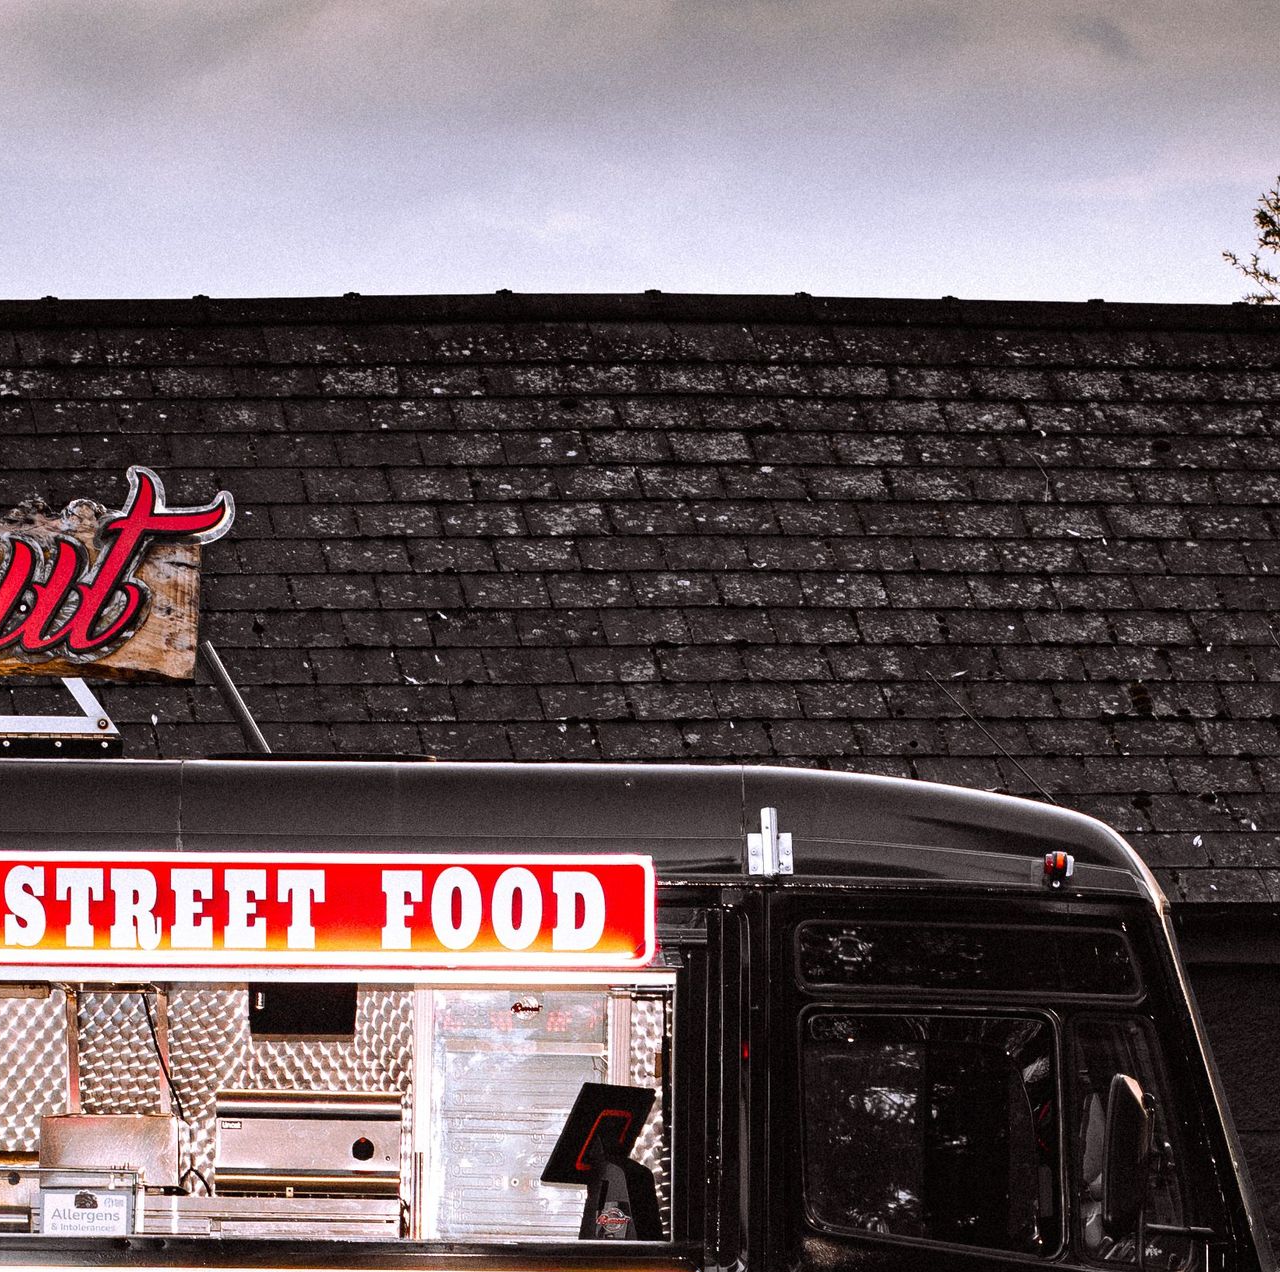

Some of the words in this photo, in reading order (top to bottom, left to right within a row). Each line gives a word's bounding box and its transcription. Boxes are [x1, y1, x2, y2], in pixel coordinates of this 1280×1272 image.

[4, 864, 326, 952] STREET
[381, 865, 607, 951] FOOD
[51, 1208, 120, 1223] Allergens
[51, 1223, 58, 1231] &
[60, 1223, 116, 1232] Intolerances
